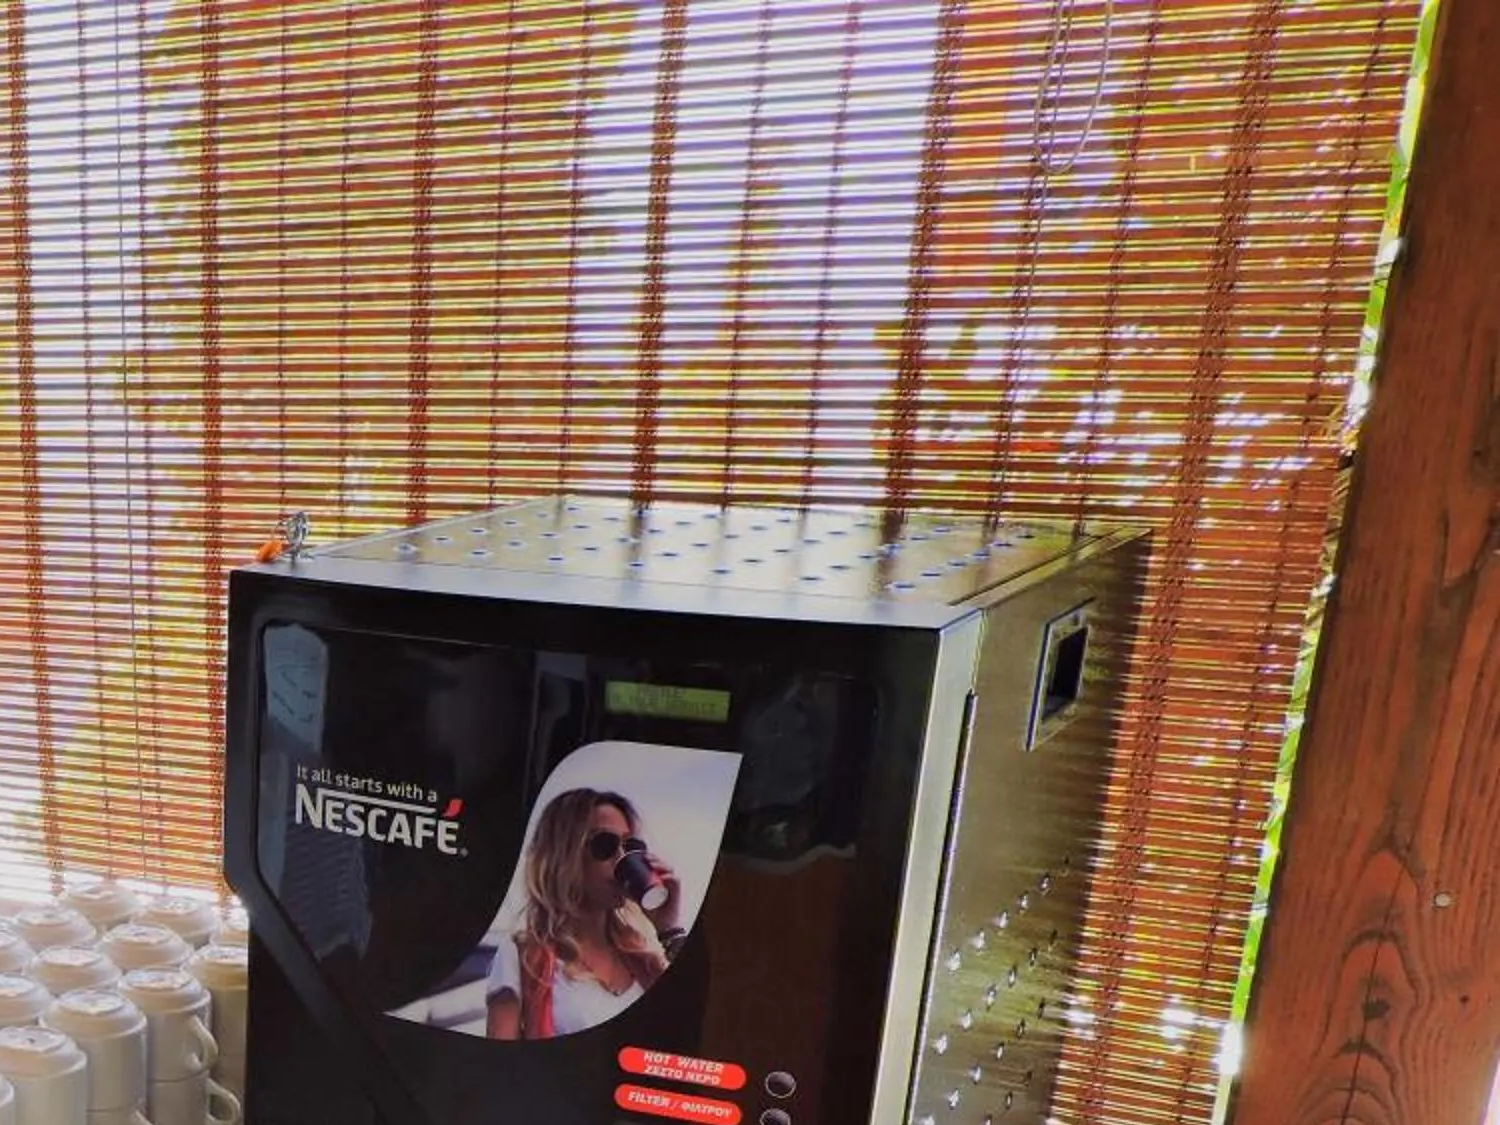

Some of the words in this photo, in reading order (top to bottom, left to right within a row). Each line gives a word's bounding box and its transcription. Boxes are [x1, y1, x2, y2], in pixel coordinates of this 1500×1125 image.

[311, 768, 332, 785] all
[335, 774, 383, 793] starts
[387, 783, 423, 800] with
[427, 790, 437, 803] a
[644, 1052, 670, 1065] HOT
[678, 1057, 724, 1073] WATER
[628, 1091, 670, 1107] FILTER
